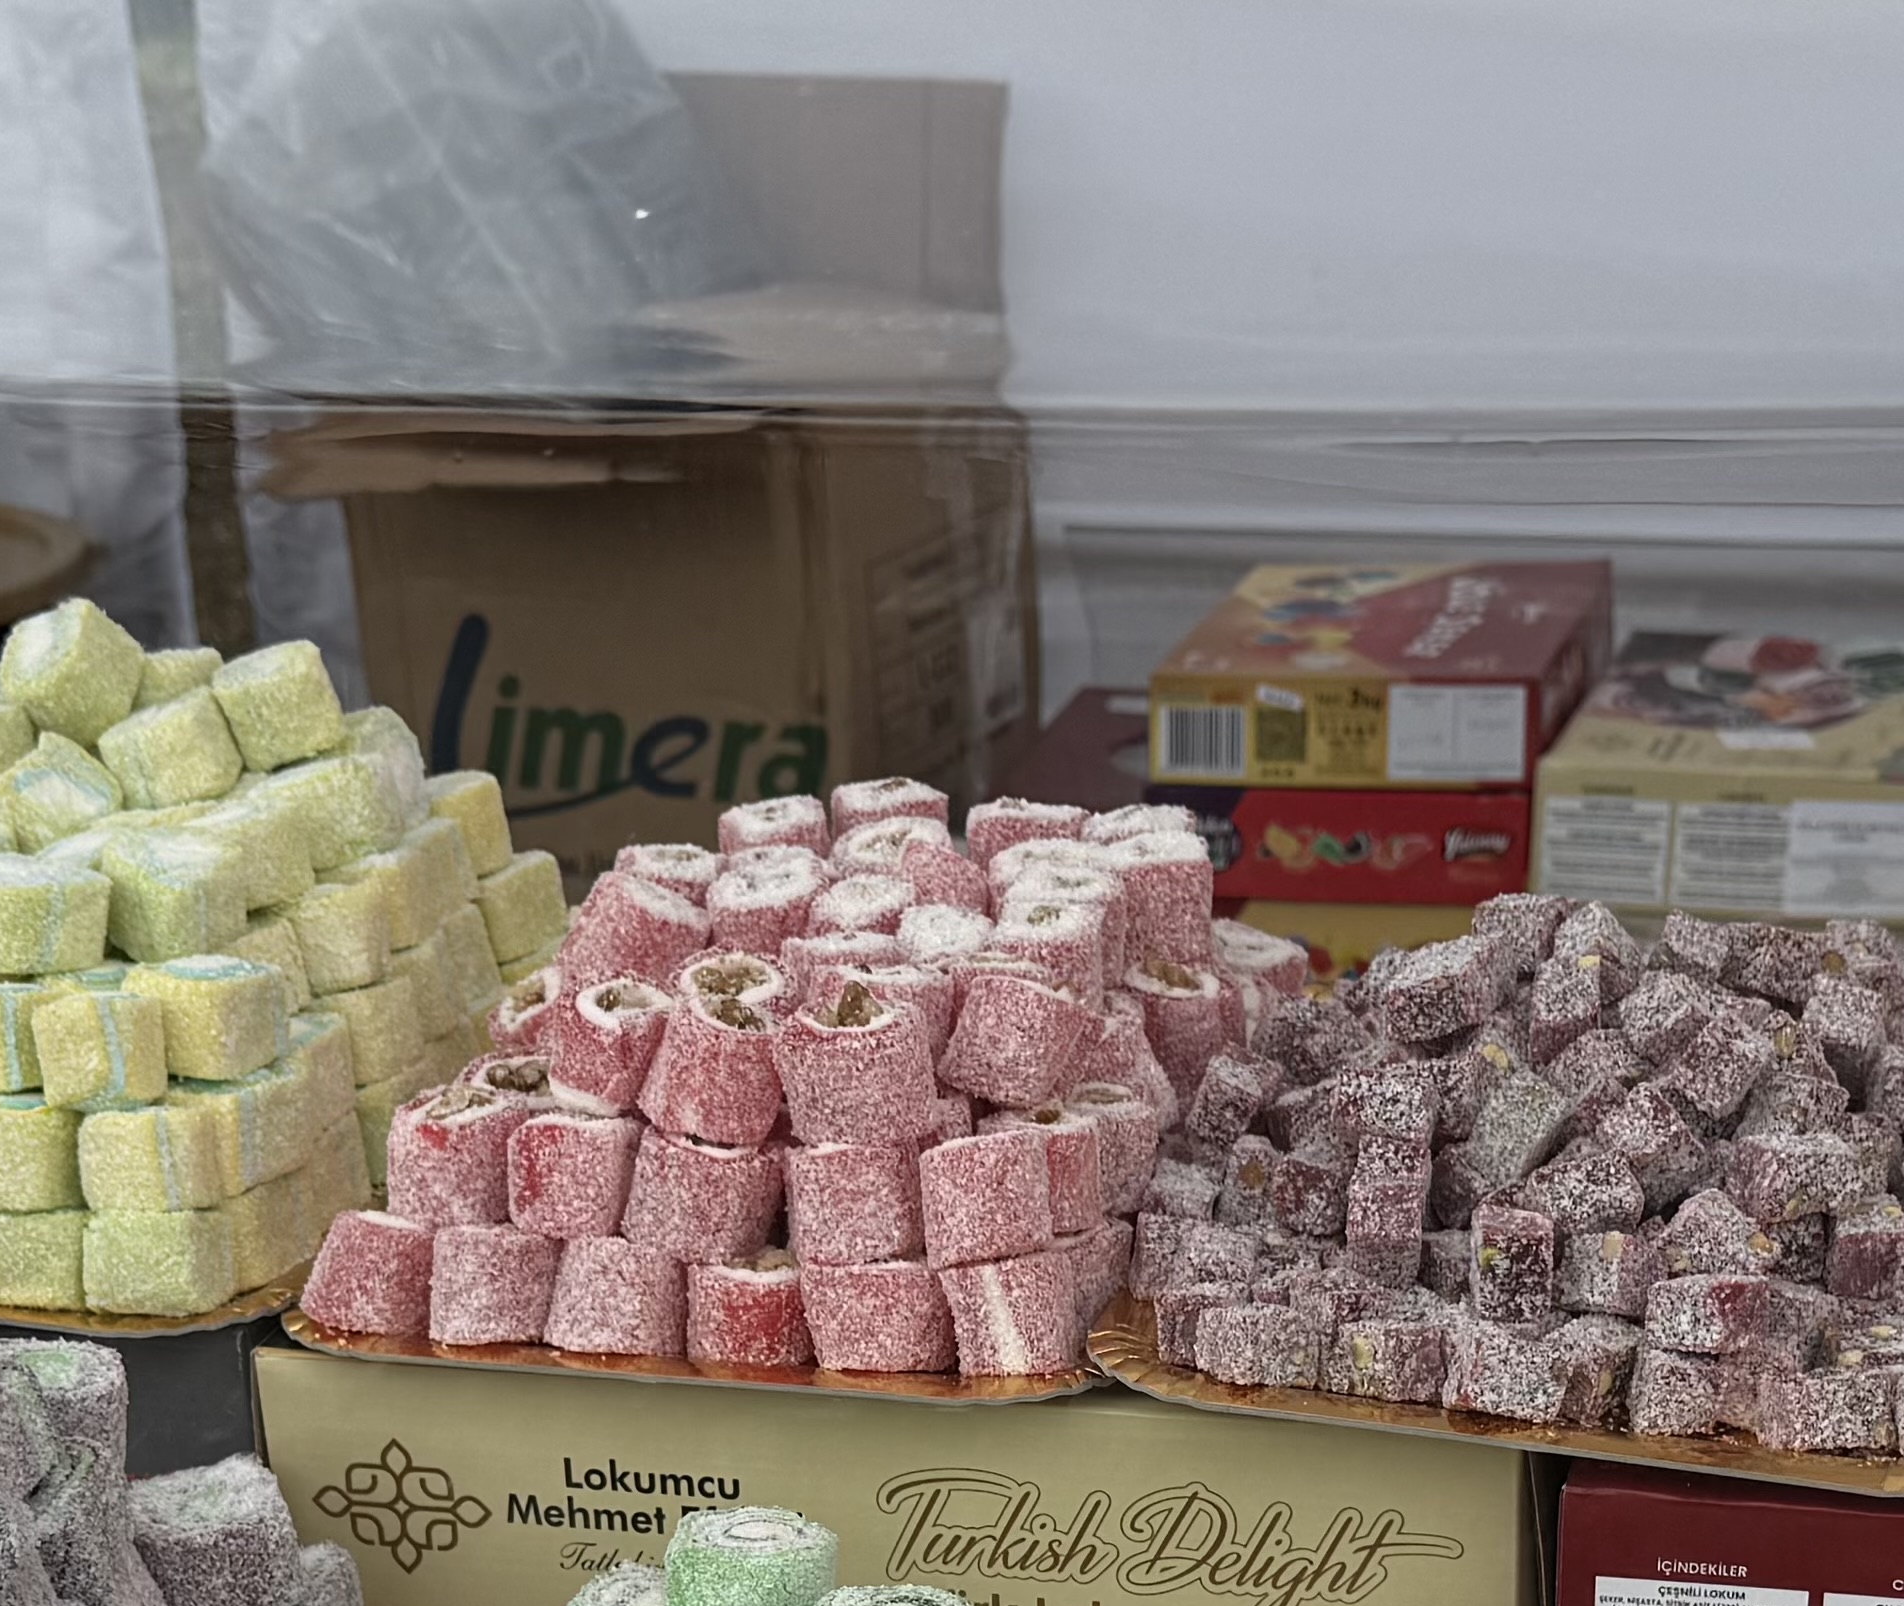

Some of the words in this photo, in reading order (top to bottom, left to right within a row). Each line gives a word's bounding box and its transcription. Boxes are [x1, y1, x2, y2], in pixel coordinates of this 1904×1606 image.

[431, 612, 830, 819] Limera
[563, 1456, 741, 1501] Lokumcu
[506, 1492, 667, 1535] Mehmet
[877, 1467, 1119, 1585] Turkish
[1656, 1555, 1748, 1581] İÇİNDEKİLER
[1656, 1583, 1702, 1600] ÇEŞNİLİ
[1703, 1588, 1746, 1601] LOKUM
